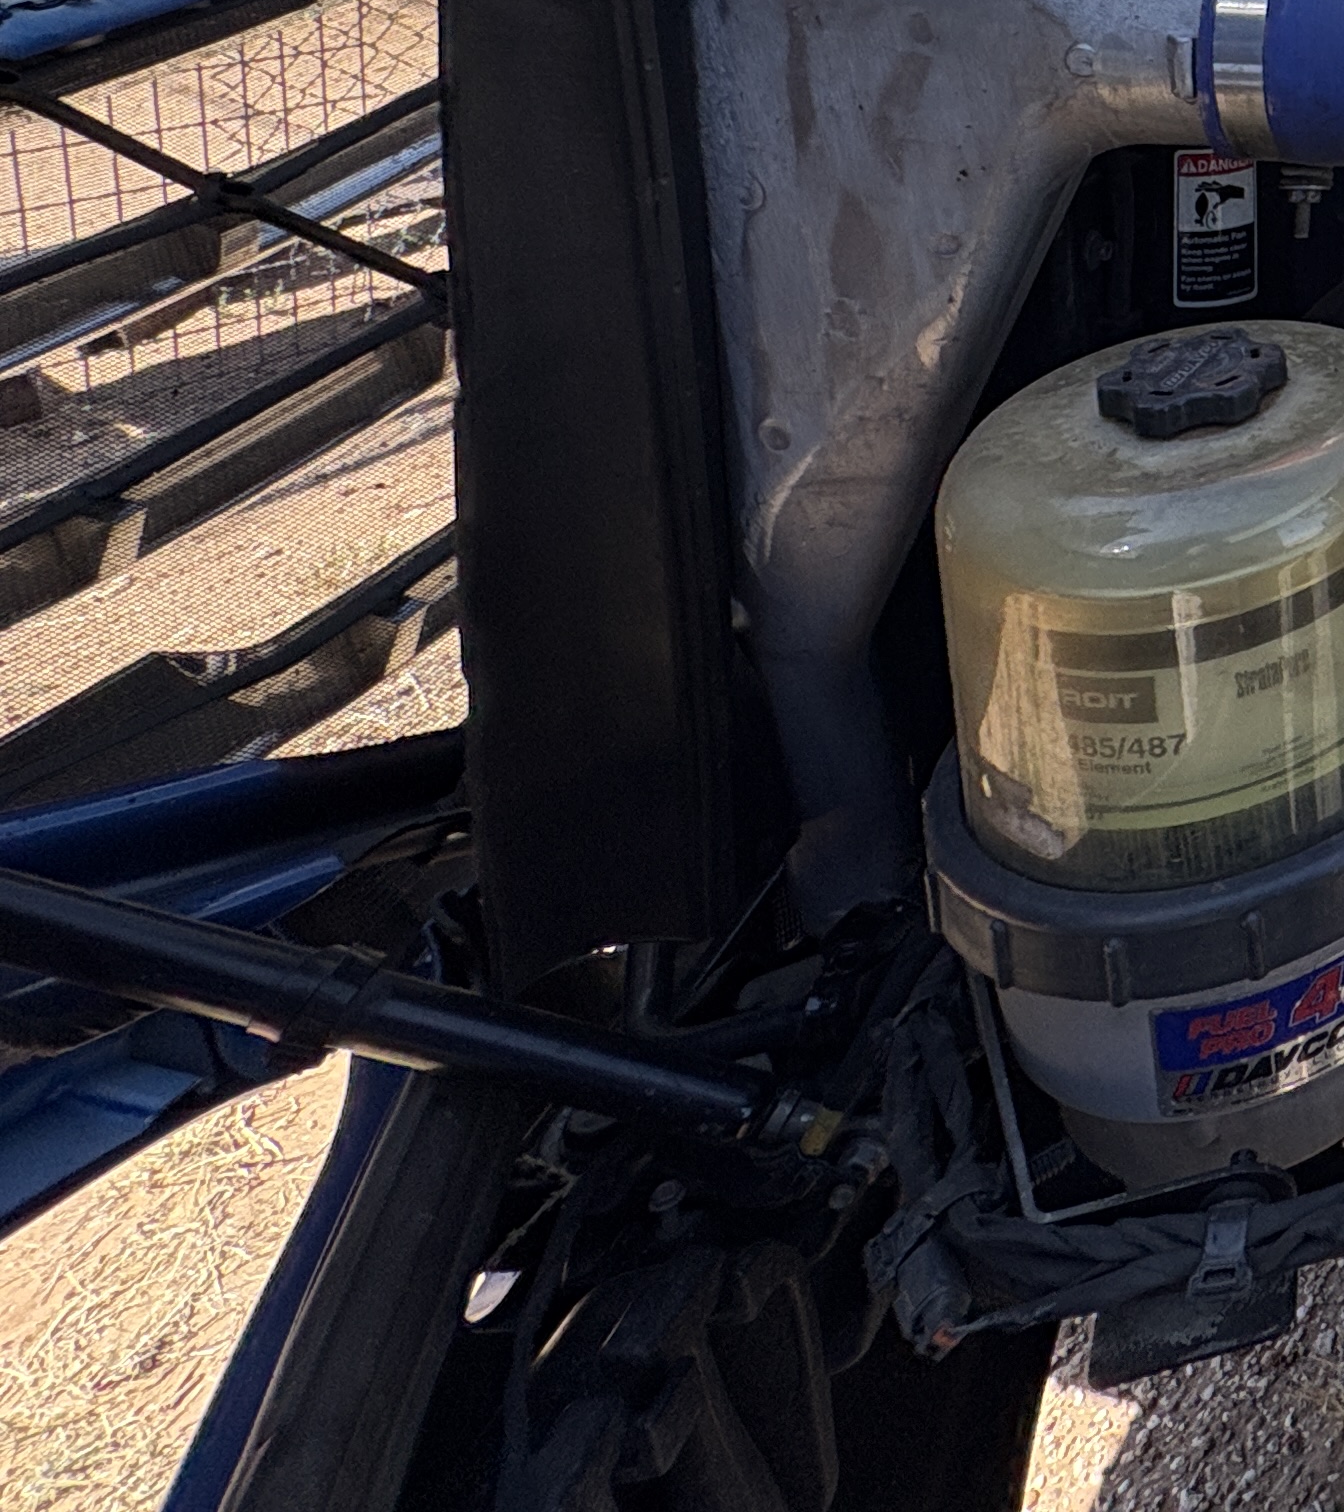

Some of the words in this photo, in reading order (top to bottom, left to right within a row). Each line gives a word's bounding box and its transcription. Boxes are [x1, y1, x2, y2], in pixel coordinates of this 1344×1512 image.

[1079, 758, 1153, 775] Element
[1188, 1000, 1278, 1039] FUEL
[1200, 1020, 1276, 1060] PRO
